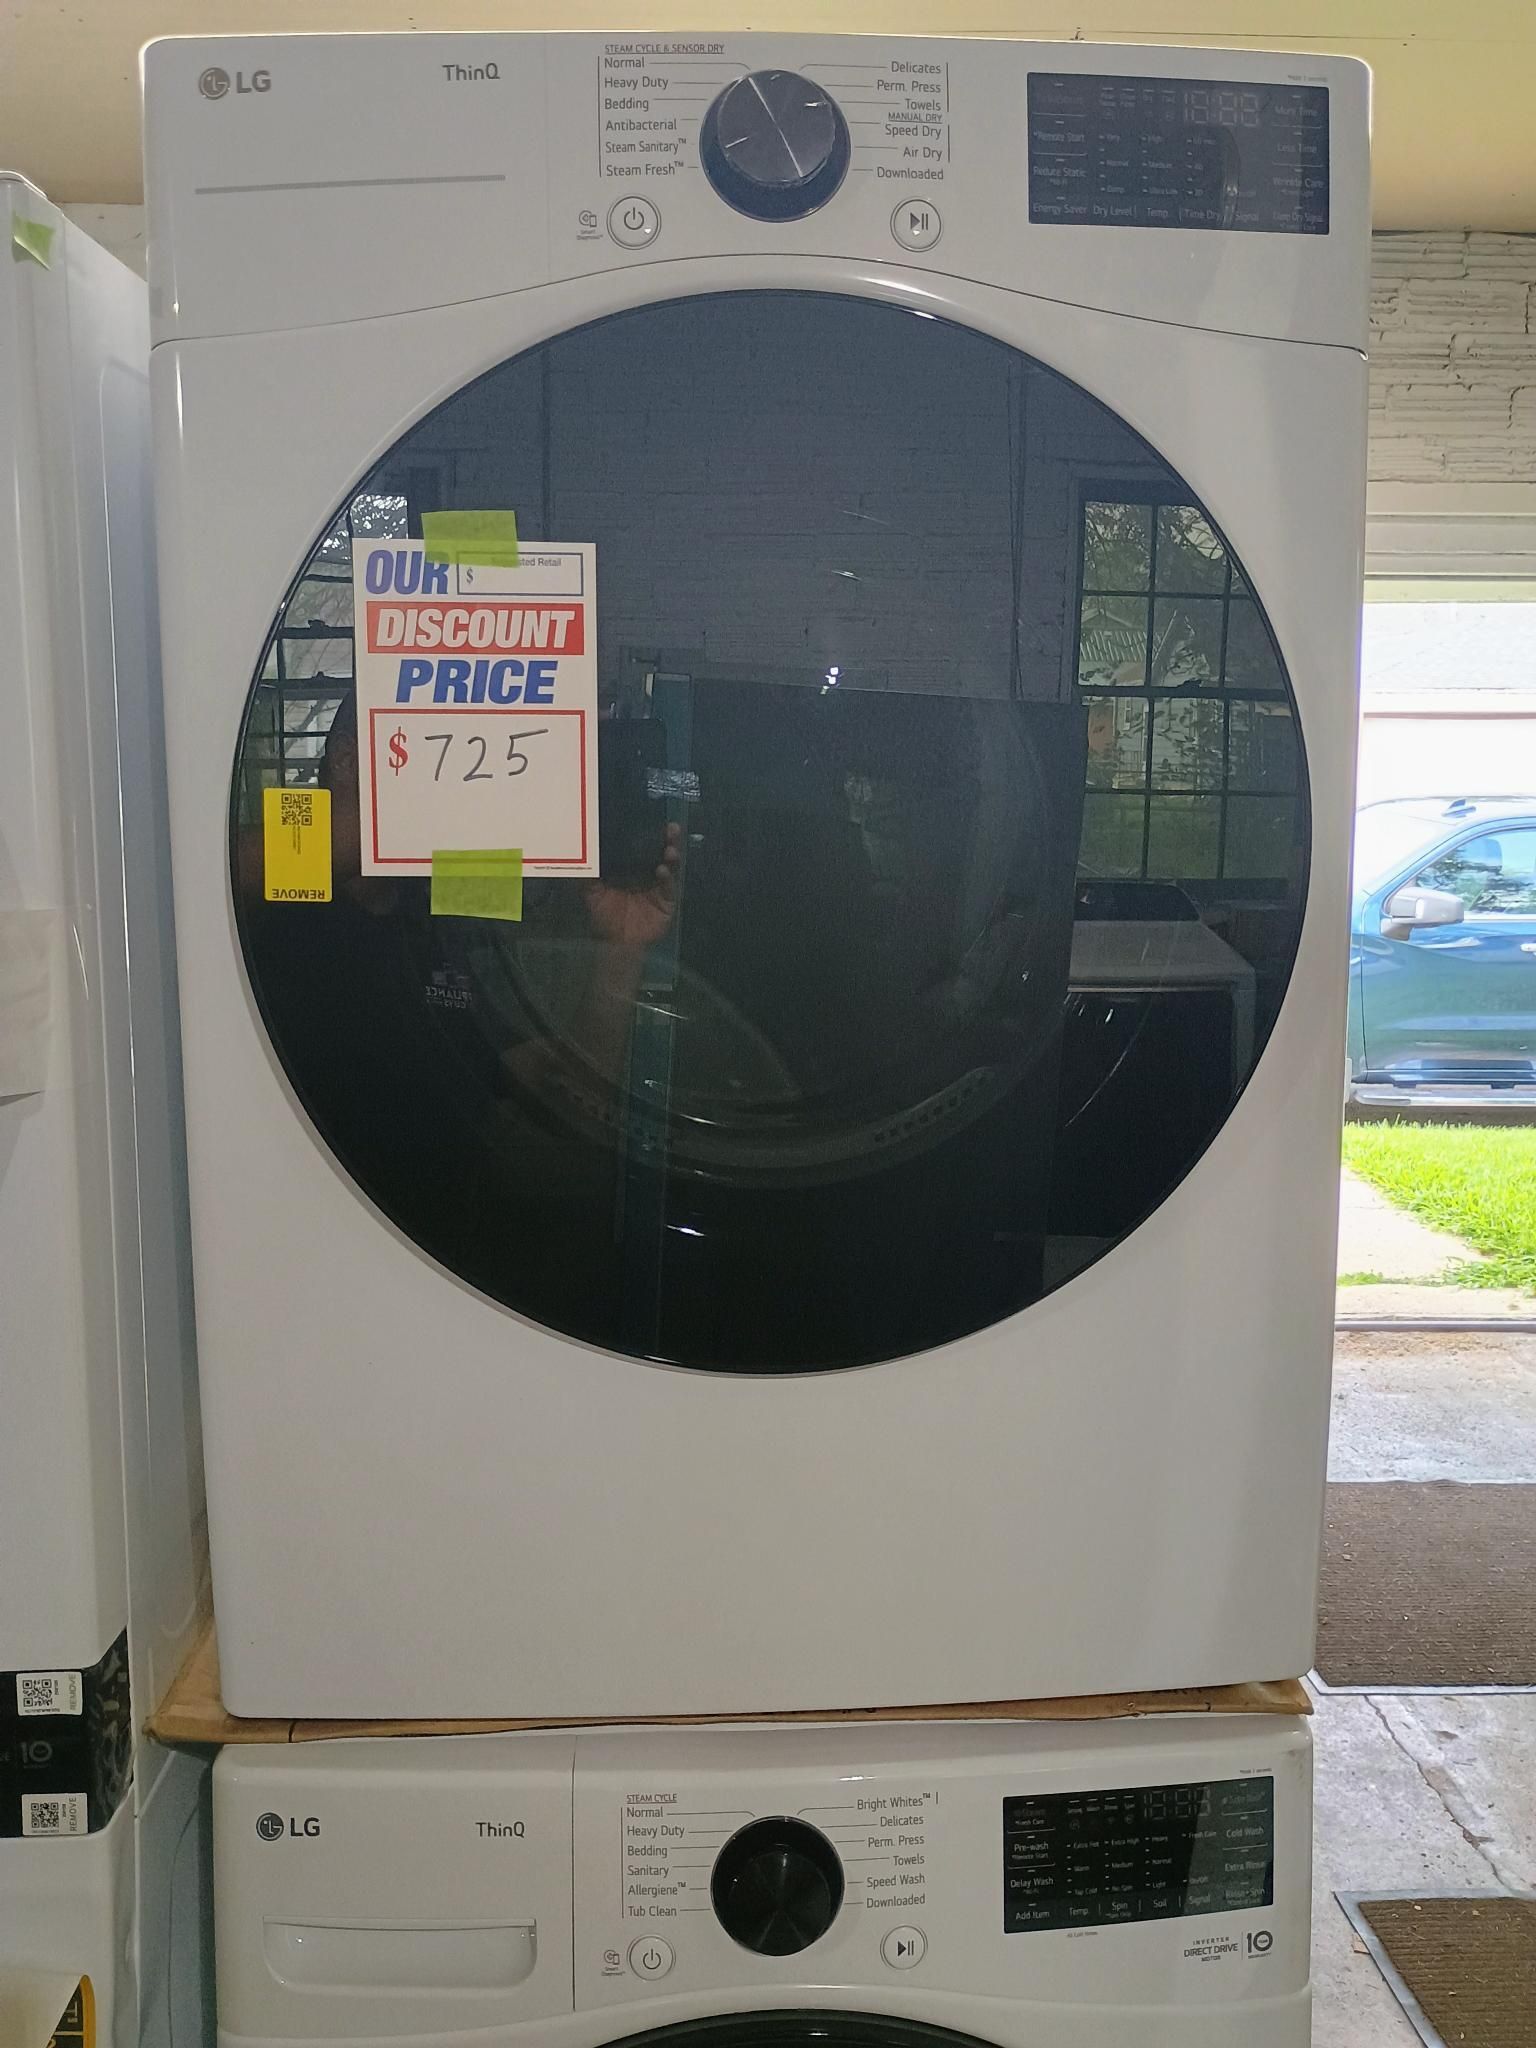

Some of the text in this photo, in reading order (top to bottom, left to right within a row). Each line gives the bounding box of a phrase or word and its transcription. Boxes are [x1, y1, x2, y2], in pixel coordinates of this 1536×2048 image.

[604, 44, 724, 53] STEAM CYCLE & SENSOR DRY
[604, 58, 645, 69] Normal
[891, 61, 941, 74] Delicates
[442, 63, 501, 81] ThinQ
[235, 71, 271, 94] LG
[604, 77, 669, 90] Heavy Duty
[877, 80, 941, 93] Perm. Press
[604, 98, 649, 112] Bedding
[906, 98, 941, 111] Towels
[888, 112, 943, 122] MANUAL DRY
[606, 119, 677, 131] Antibacterial
[885, 124, 942, 140] Speed Dry
[606, 142, 636, 154] Steam
[903, 147, 943, 161] Air Dry
[606, 165, 641, 177] Steam
[877, 167, 944, 180] Downloaded
[1033, 203, 1061, 215] Energy
[1094, 205, 1108, 217] Dry
[538, 558, 562, 567] Retail
[365, 550, 449, 595] OUR
[466, 568, 474, 585] $
[376, 608, 576, 649] DISCOUNT
[395, 659, 559, 704] PRICE
[272, 889, 326, 900] REMOVE
[69, 1673, 77, 1711] REMOVE
[626, 1793, 677, 1803] STEAM CYCLE
[857, 1798, 887, 1812] Bright
[627, 1807, 664, 1818] Normal
[290, 1817, 321, 1837] LG
[880, 1815, 924, 1827] Delicates
[475, 1821, 525, 1839] ThinQ
[627, 1825, 685, 1838] Heavy Duty
[1226, 1828, 1243, 1839] Cold
[868, 1835, 925, 1848] Perm. Press
[1014, 1841, 1049, 1852] Pre-wash
[627, 1845, 668, 1859] Bedding
[893, 1853, 925, 1866] Towels
[627, 1865, 669, 1879] Sanitary
[867, 1873, 926, 1890] Speed Wash
[1010, 1877, 1054, 1889] Delay Wash
[866, 1894, 926, 1909] Downloaded
[1111, 1901, 1128, 1911] Spin
[1153, 1899, 1167, 1908] Soil
[628, 1905, 677, 1917] Tub Clean
[1015, 1911, 1031, 1920] Add
[1193, 1936, 1230, 1945] INVERTER
[1246, 1930, 1274, 1953] 10
[1184, 1943, 1239, 1958] DIRECT DRIVE
